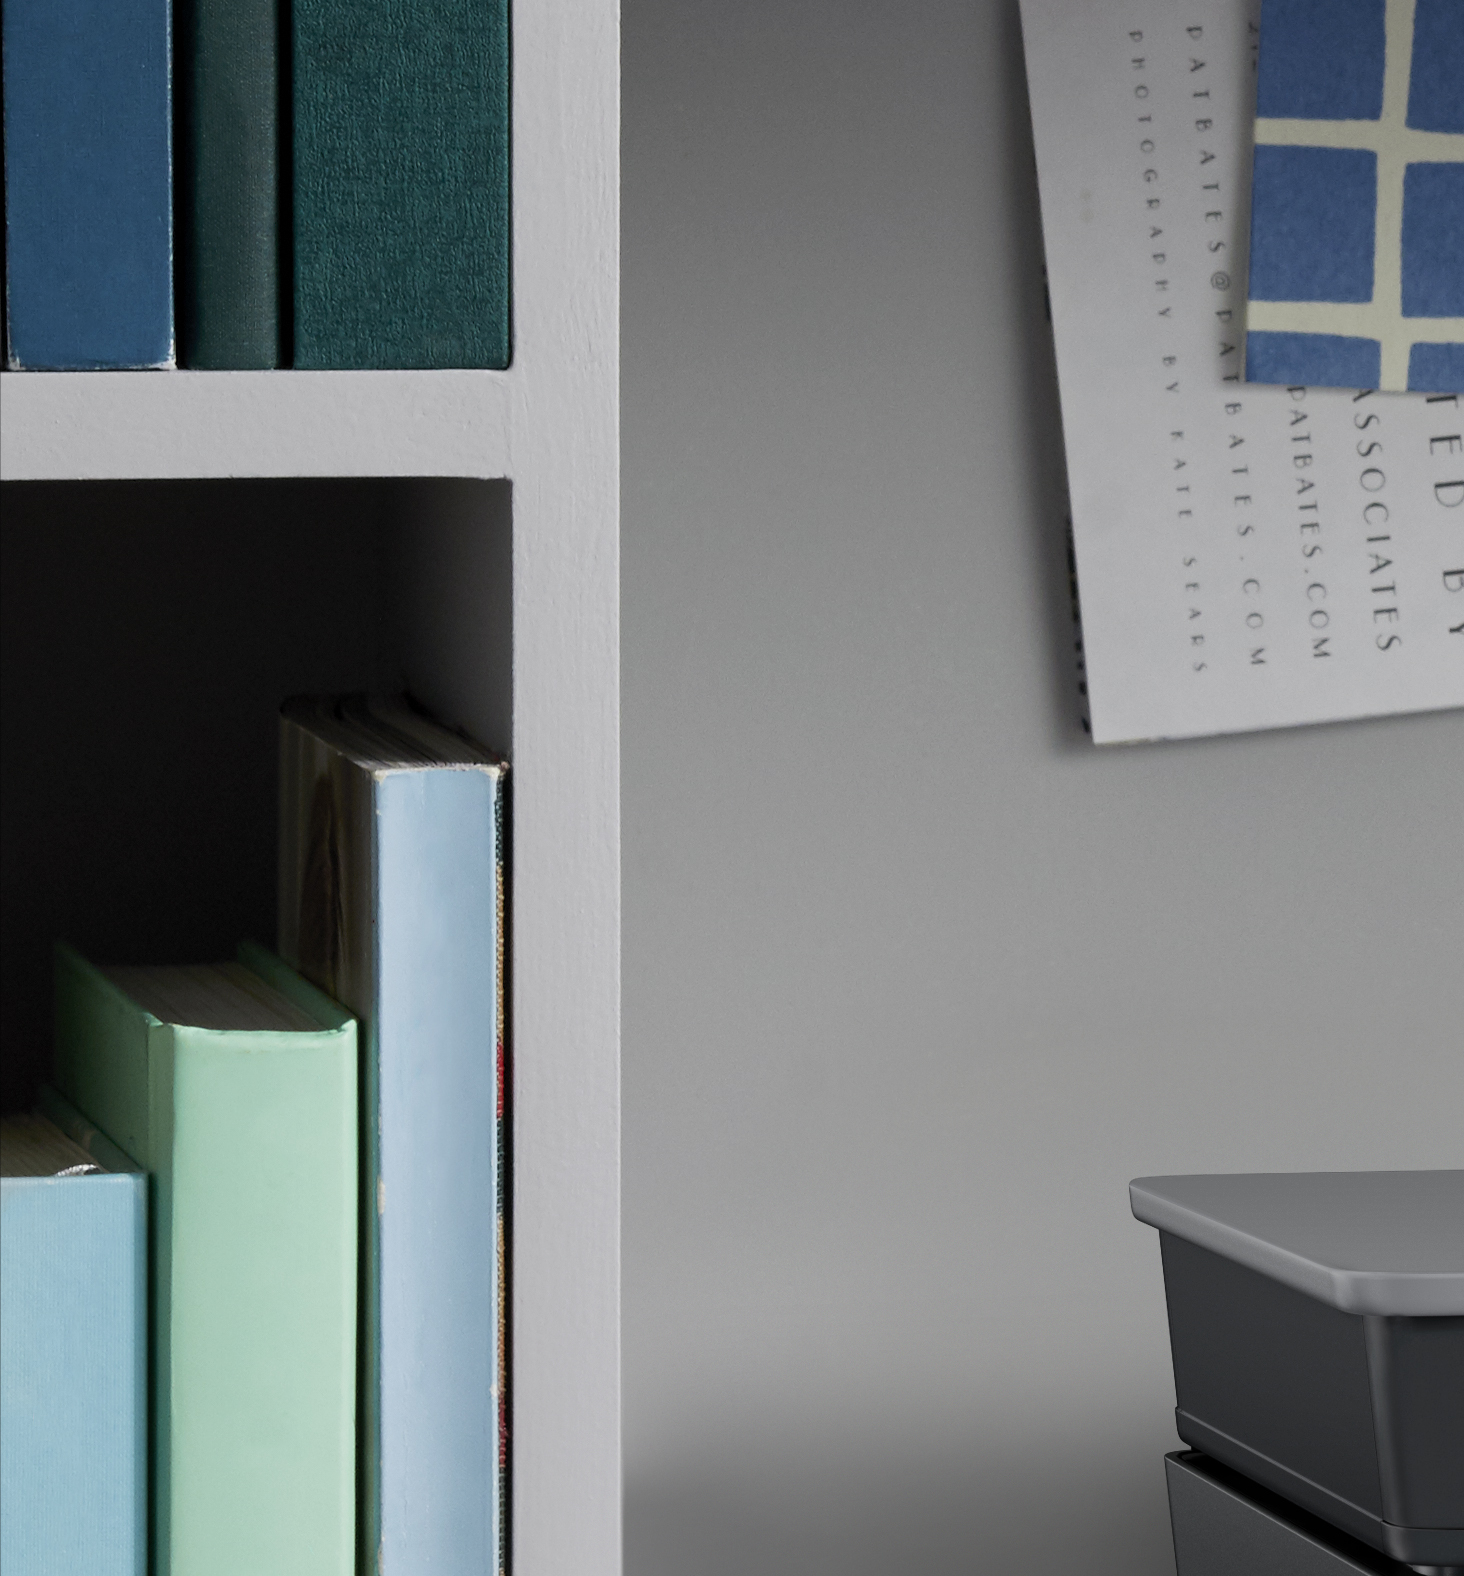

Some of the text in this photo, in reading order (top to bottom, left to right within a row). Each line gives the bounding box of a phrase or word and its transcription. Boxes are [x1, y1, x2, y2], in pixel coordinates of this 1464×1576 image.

[1128, 30, 1210, 675] PHOTOGRAPHY BY KATE SEARS
